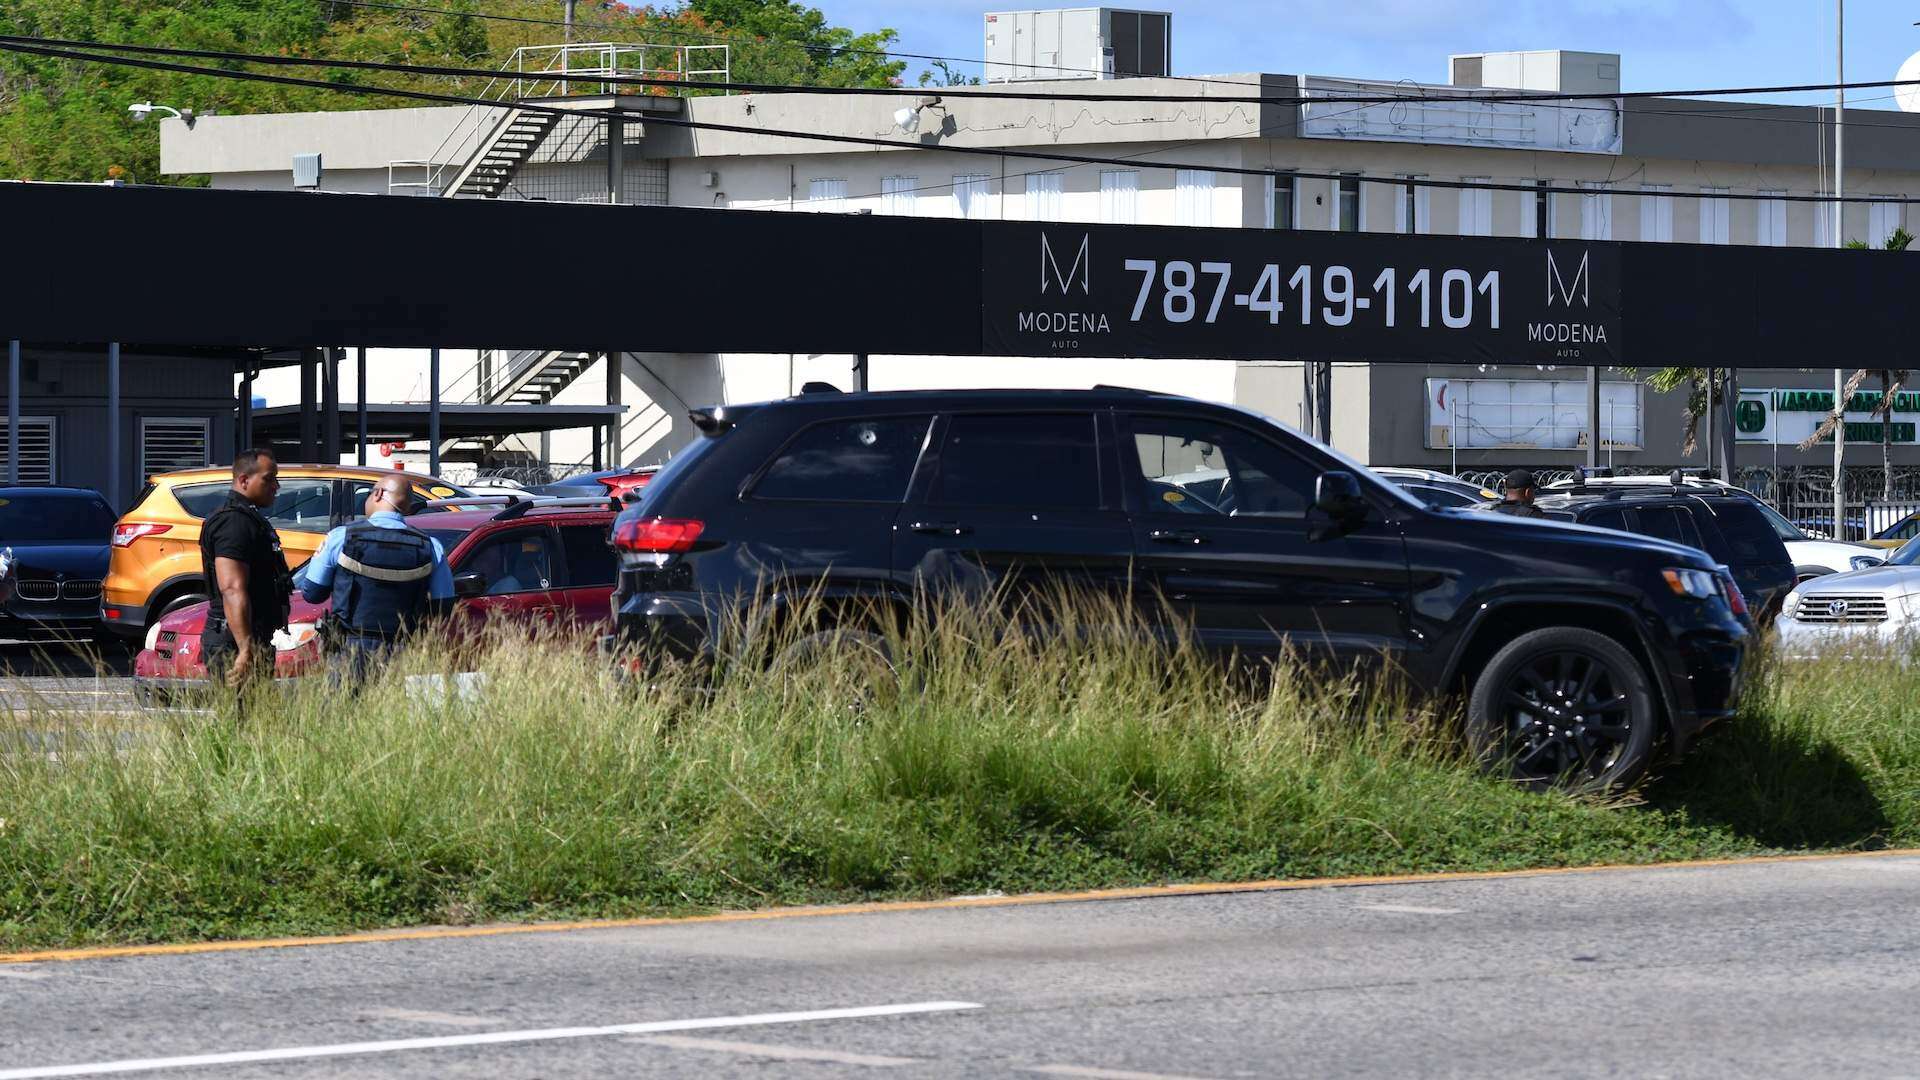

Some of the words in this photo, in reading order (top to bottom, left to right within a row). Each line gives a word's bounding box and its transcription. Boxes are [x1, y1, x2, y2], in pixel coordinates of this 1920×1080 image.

[1124, 258, 1500, 329] 787-419-1101
[1018, 311, 1111, 333] MODENA
[1528, 322, 1607, 343] MODENA
[1051, 340, 1079, 349] AUTO
[1556, 349, 1580, 358] AUTO
